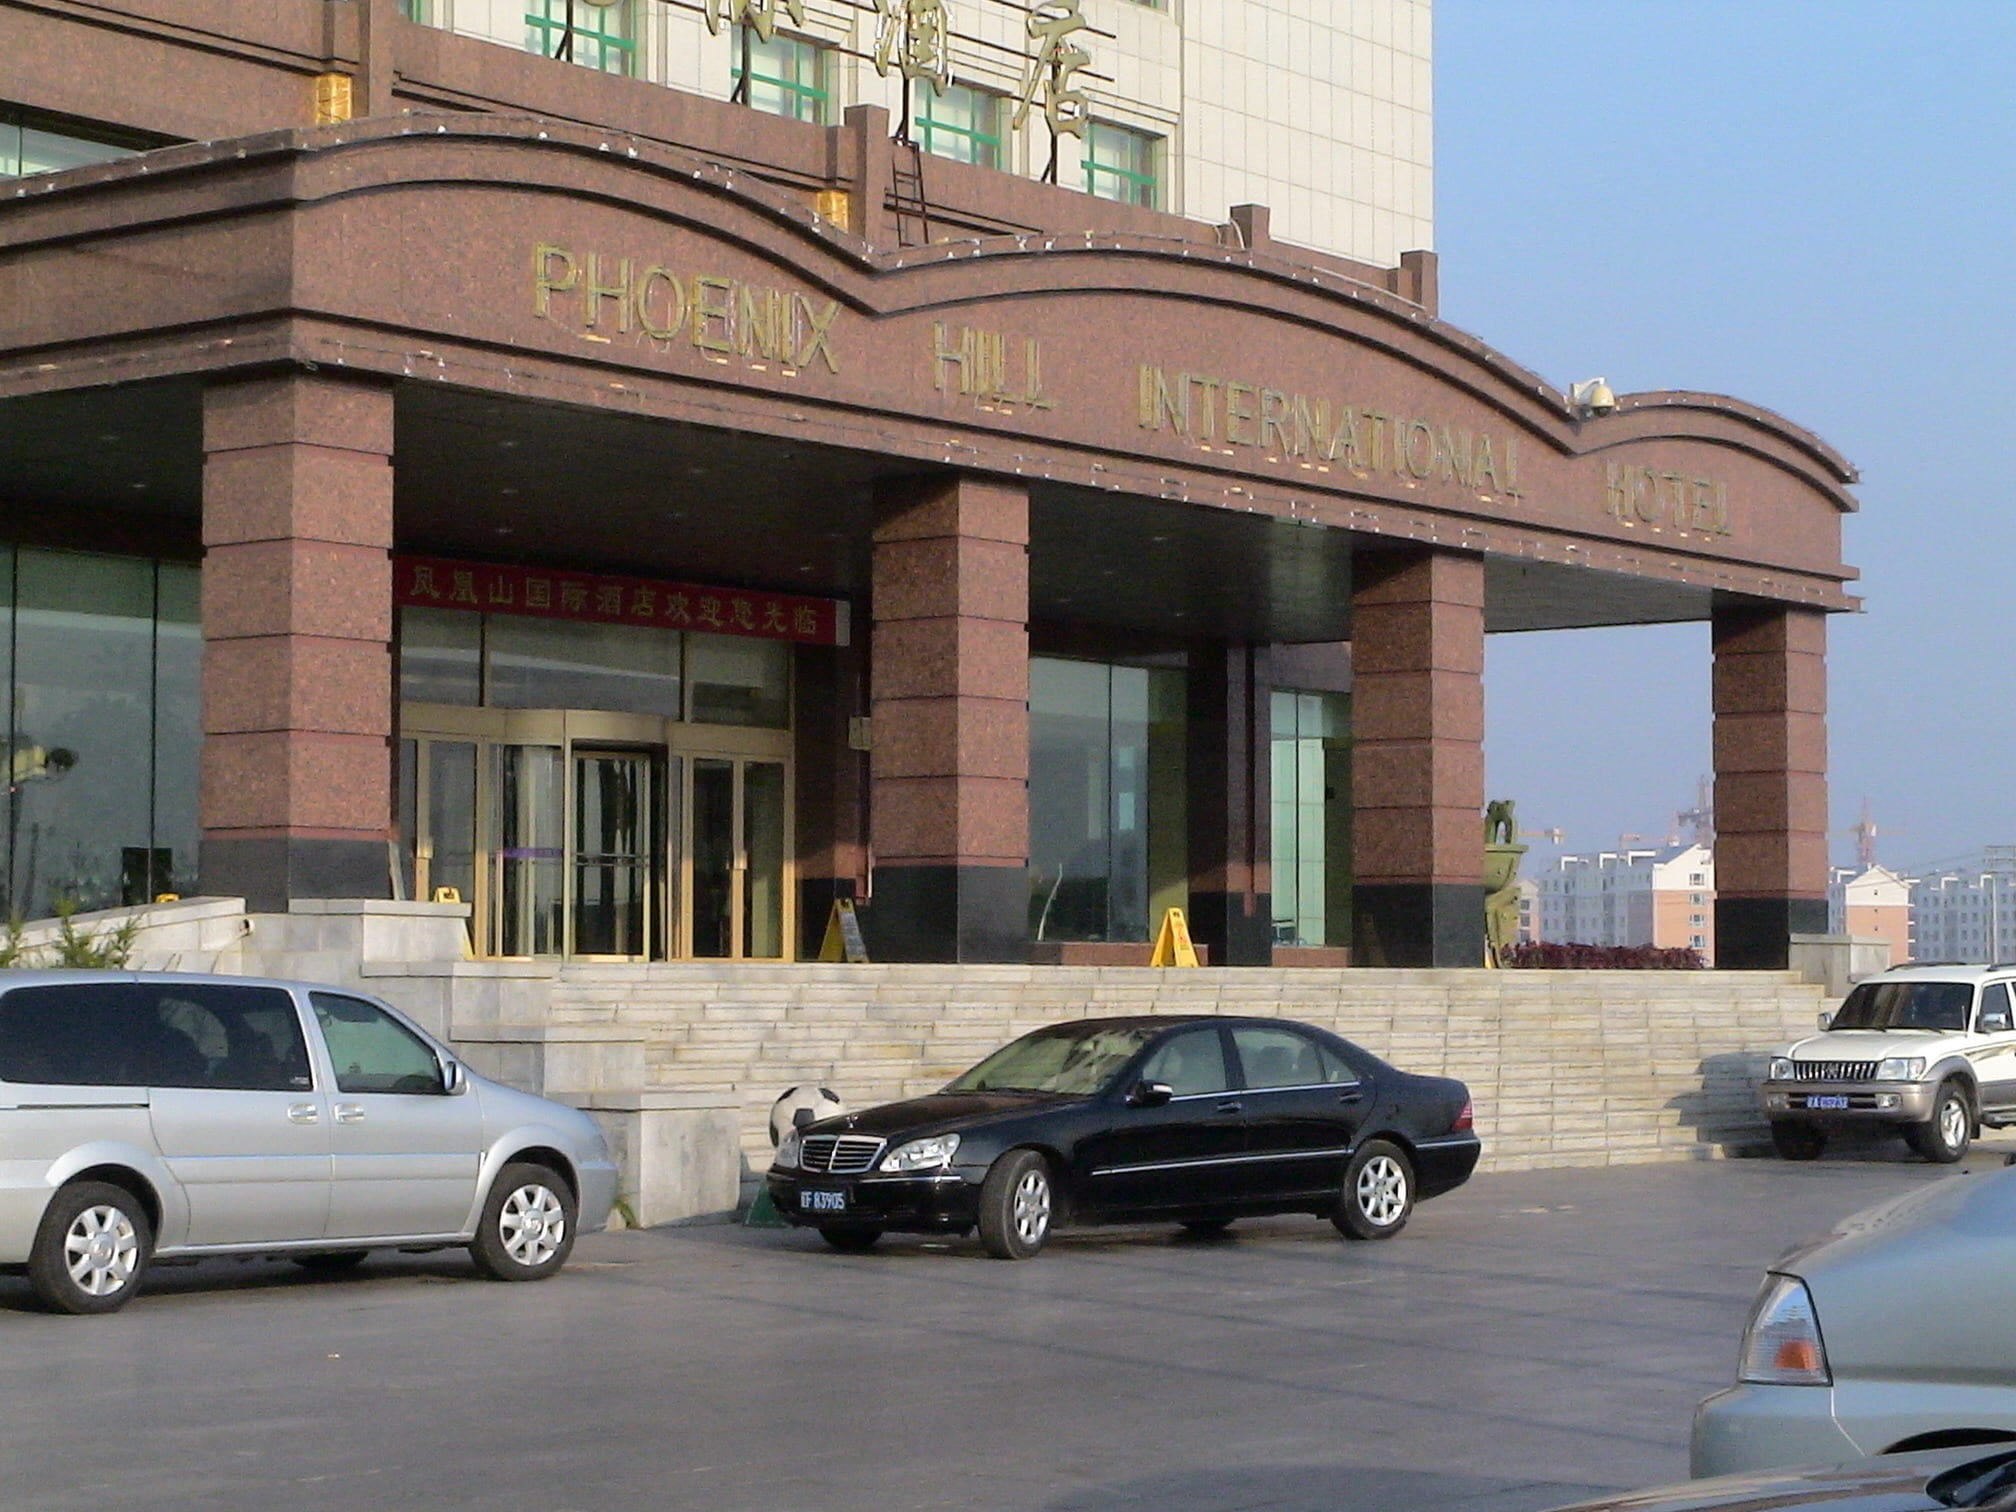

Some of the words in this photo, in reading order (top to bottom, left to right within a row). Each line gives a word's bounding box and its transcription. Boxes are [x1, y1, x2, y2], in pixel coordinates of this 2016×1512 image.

[534, 240, 839, 374] PHOENIX
[932, 319, 1057, 410] HILL
[1138, 364, 1523, 500] INTERNATIONAL
[1605, 458, 1732, 537] HOTEL
[409, 565, 817, 635] 凤凰山国际酒店欢迎您光临
